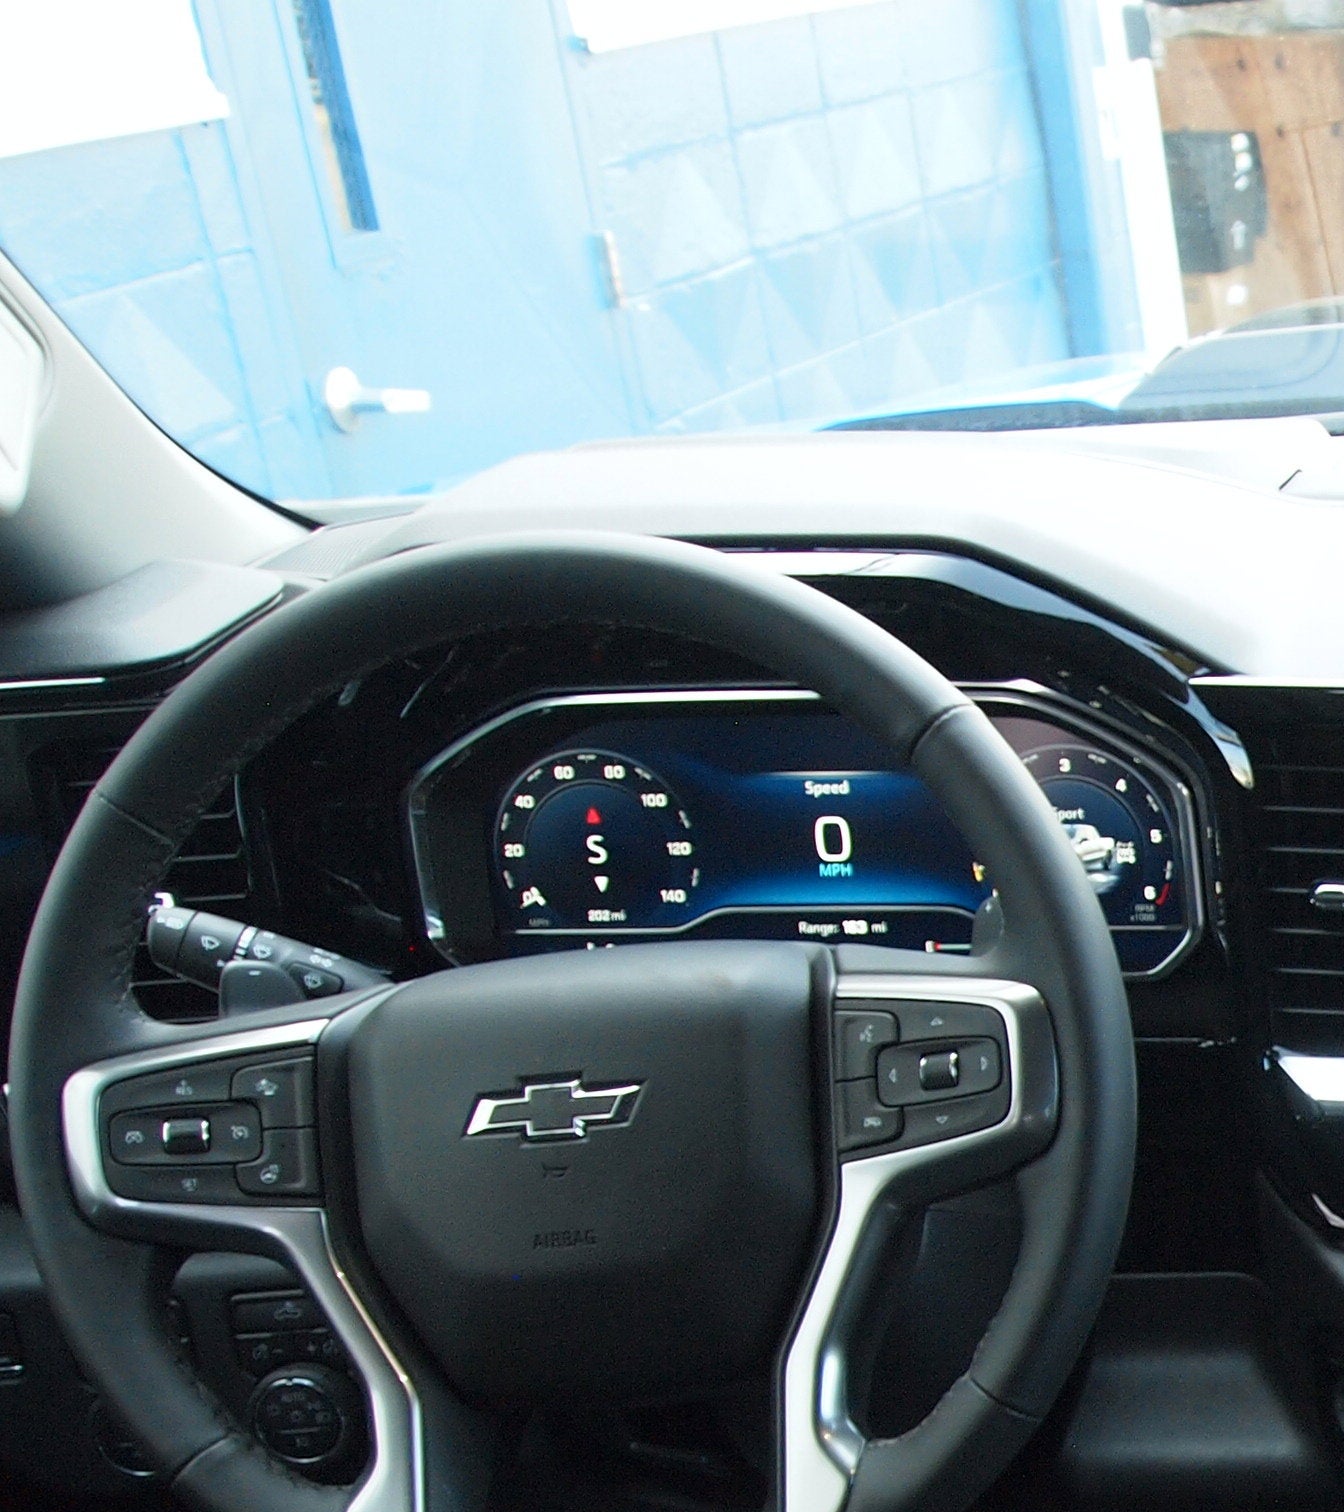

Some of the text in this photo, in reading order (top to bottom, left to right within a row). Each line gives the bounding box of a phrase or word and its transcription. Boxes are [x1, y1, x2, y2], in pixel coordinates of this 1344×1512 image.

[554, 765, 575, 780] 60
[1059, 758, 1071, 772] 3
[804, 780, 850, 798] Speed
[1115, 778, 1127, 792] 4
[514, 795, 535, 809] 40
[640, 793, 668, 808] 100
[814, 815, 852, 862] 0
[504, 843, 525, 858] 20
[585, 834, 608, 865] S
[666, 841, 693, 856] 120
[819, 863, 852, 877] MPH
[660, 889, 687, 903] 140
[1144, 885, 1156, 900] 6
[798, 921, 839, 937] Range:
